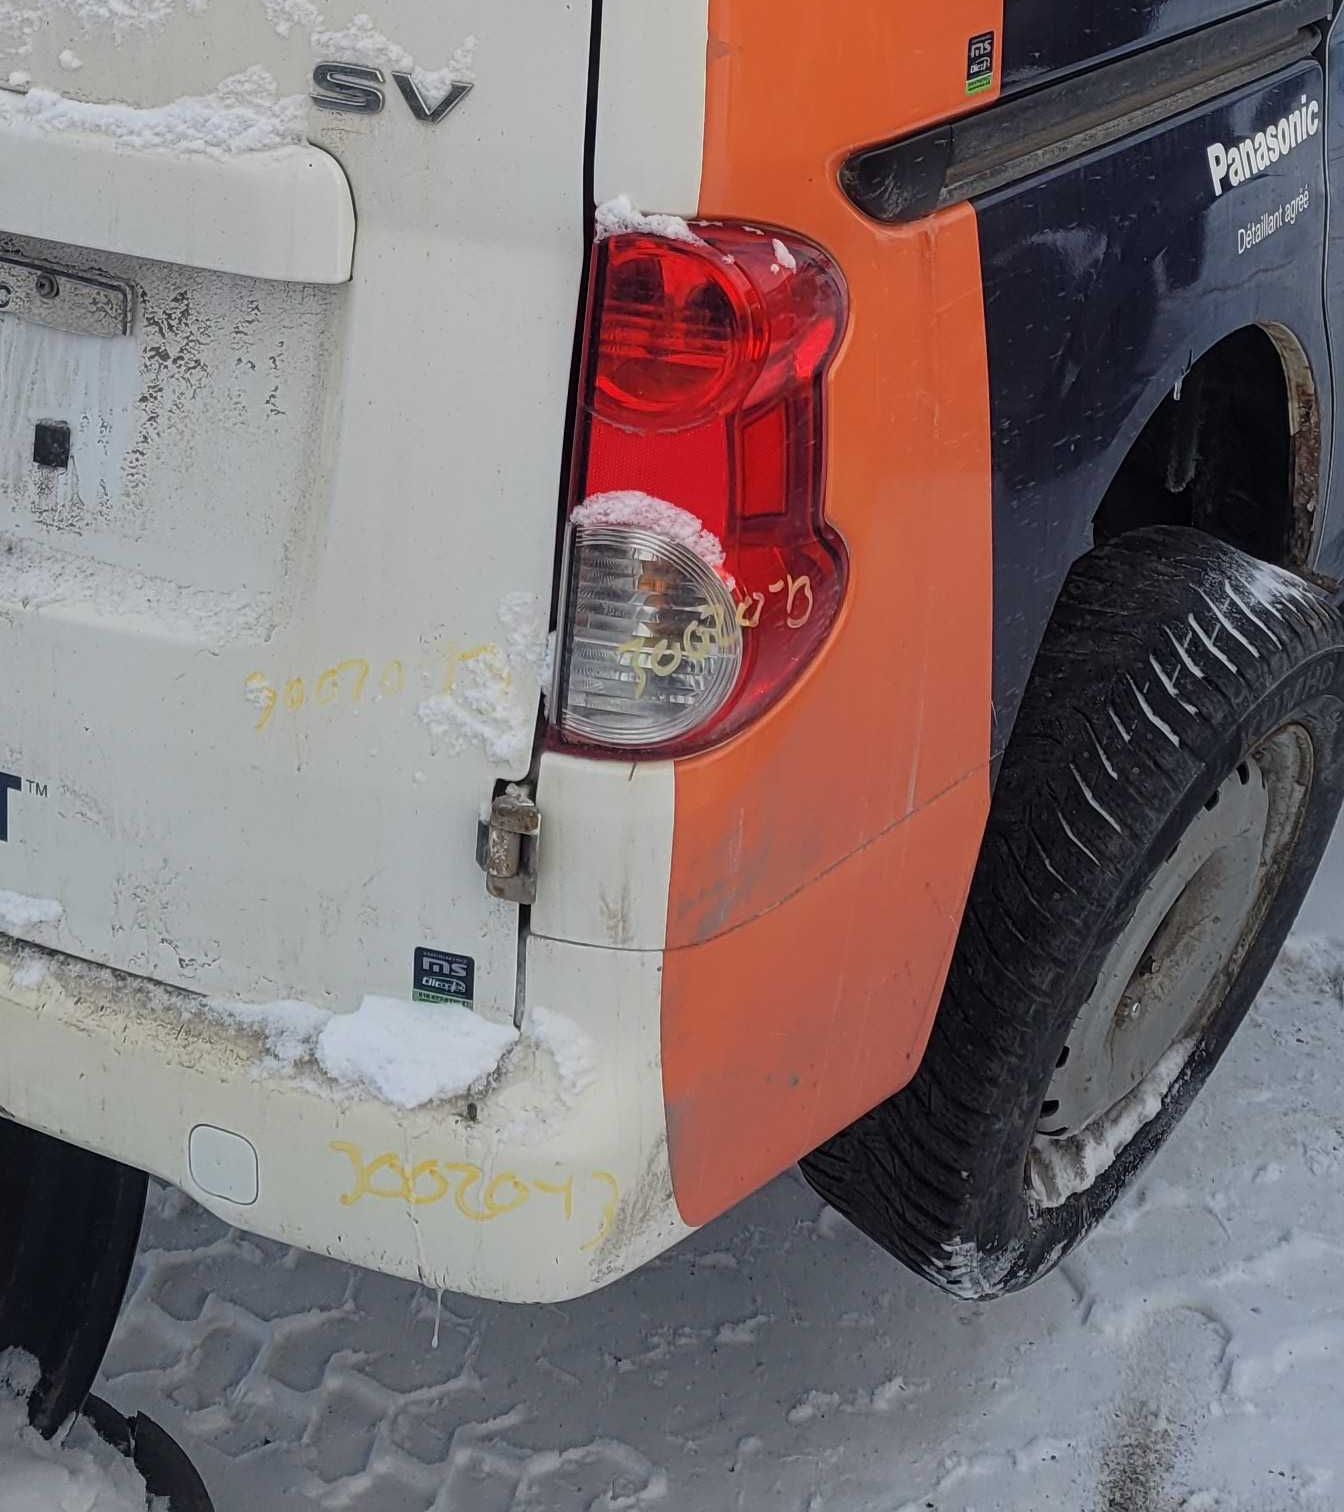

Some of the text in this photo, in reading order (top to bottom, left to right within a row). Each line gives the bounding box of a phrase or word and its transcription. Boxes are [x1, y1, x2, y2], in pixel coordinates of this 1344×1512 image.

[309, 61, 474, 125] SV
[1207, 94, 1320, 197] Panasonic
[1238, 184, 1310, 255] Détaillant agréé
